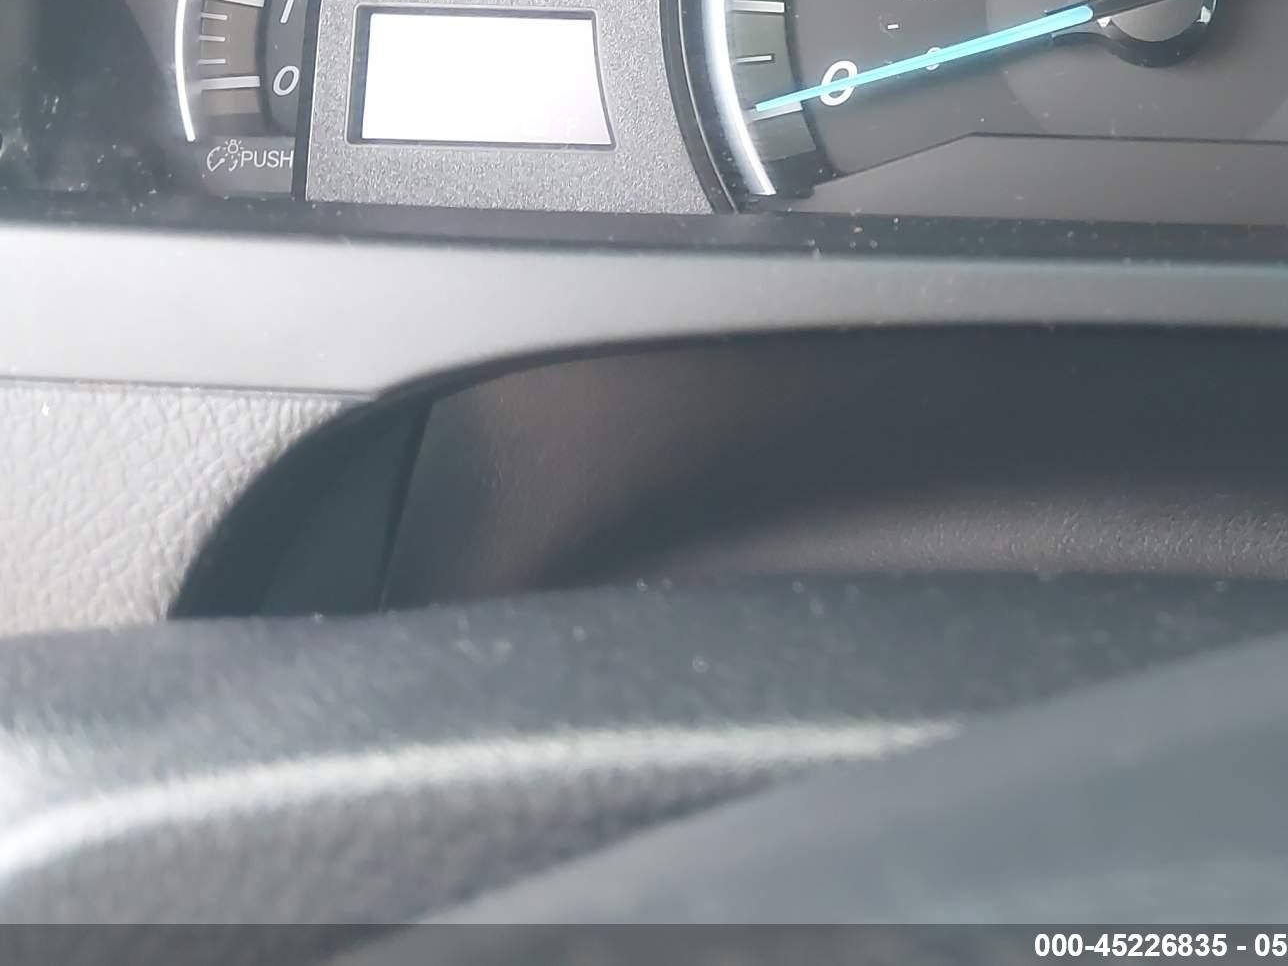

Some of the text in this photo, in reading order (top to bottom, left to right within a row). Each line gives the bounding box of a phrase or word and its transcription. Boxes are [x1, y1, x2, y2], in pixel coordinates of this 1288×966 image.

[274, 66, 299, 95] 0
[820, 60, 858, 106] 0
[241, 151, 294, 168] PUSH
